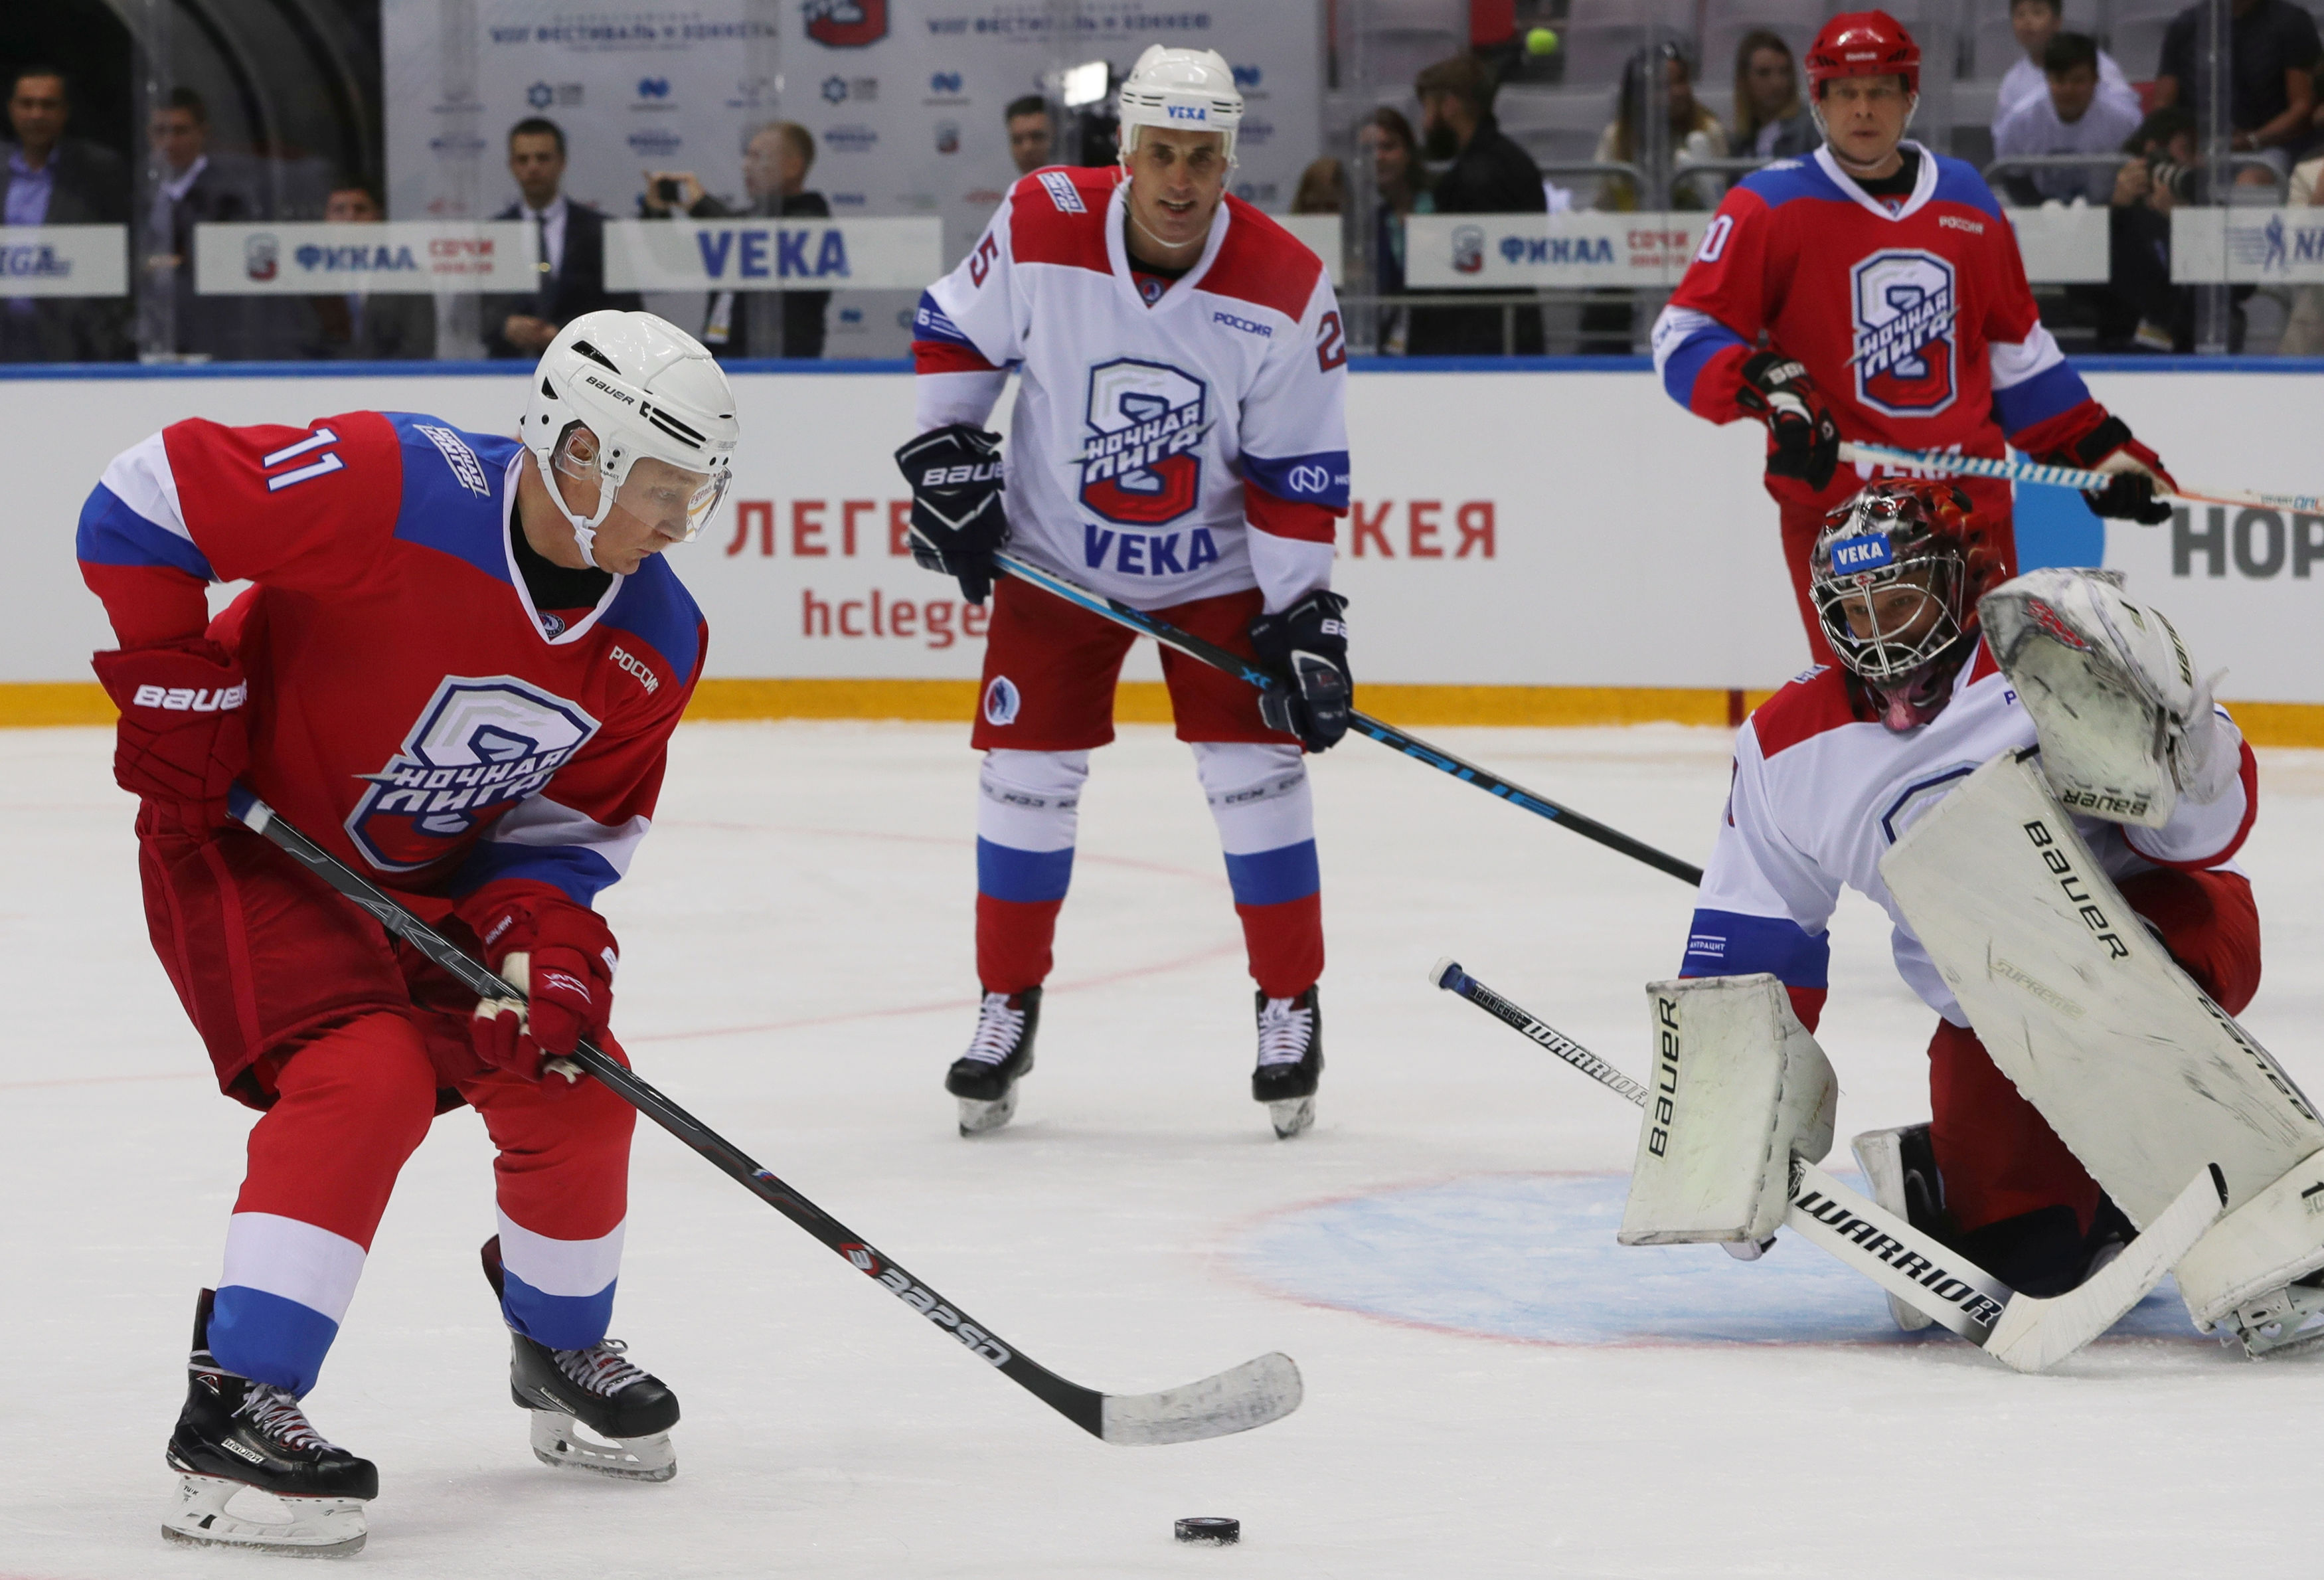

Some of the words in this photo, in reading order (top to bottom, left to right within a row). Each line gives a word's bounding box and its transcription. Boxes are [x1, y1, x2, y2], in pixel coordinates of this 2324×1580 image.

[1168, 106, 1205, 120] VEKA
[1499, 236, 1614, 263] ФИНАЛ
[1939, 217, 1983, 235] РОССИЯ
[697, 230, 850, 278] VEKA
[1214, 311, 1272, 337] РОССИЯ
[1862, 288, 1948, 356] НОЧНАЯ
[1863, 310, 1952, 379] ЛИГА
[586, 376, 635, 405] BAUER
[1086, 425, 1199, 483] ЛИГА
[1088, 403, 1200, 460] НОЧНАЯ
[263, 426, 345, 493] 11
[1084, 524, 1219, 576] VEKA
[1335, 499, 1495, 559] КЕЯ
[1837, 541, 1884, 565] VEKA
[609, 645, 659, 695] РОССИЯ
[376, 773, 544, 813] ЛИГА
[395, 746, 570, 790] НОЧНАЯ
[2063, 788, 2151, 818] BAUER
[2023, 820, 2129, 960] BAUER
[1992, 957, 2086, 1019] SUPREME
[1524, 1020, 1649, 1108] WARRIOR
[1649, 996, 1680, 1158] BAUER
[2198, 997, 2316, 1120] BAUER
[1795, 1190, 2004, 1328] WARRIOR
